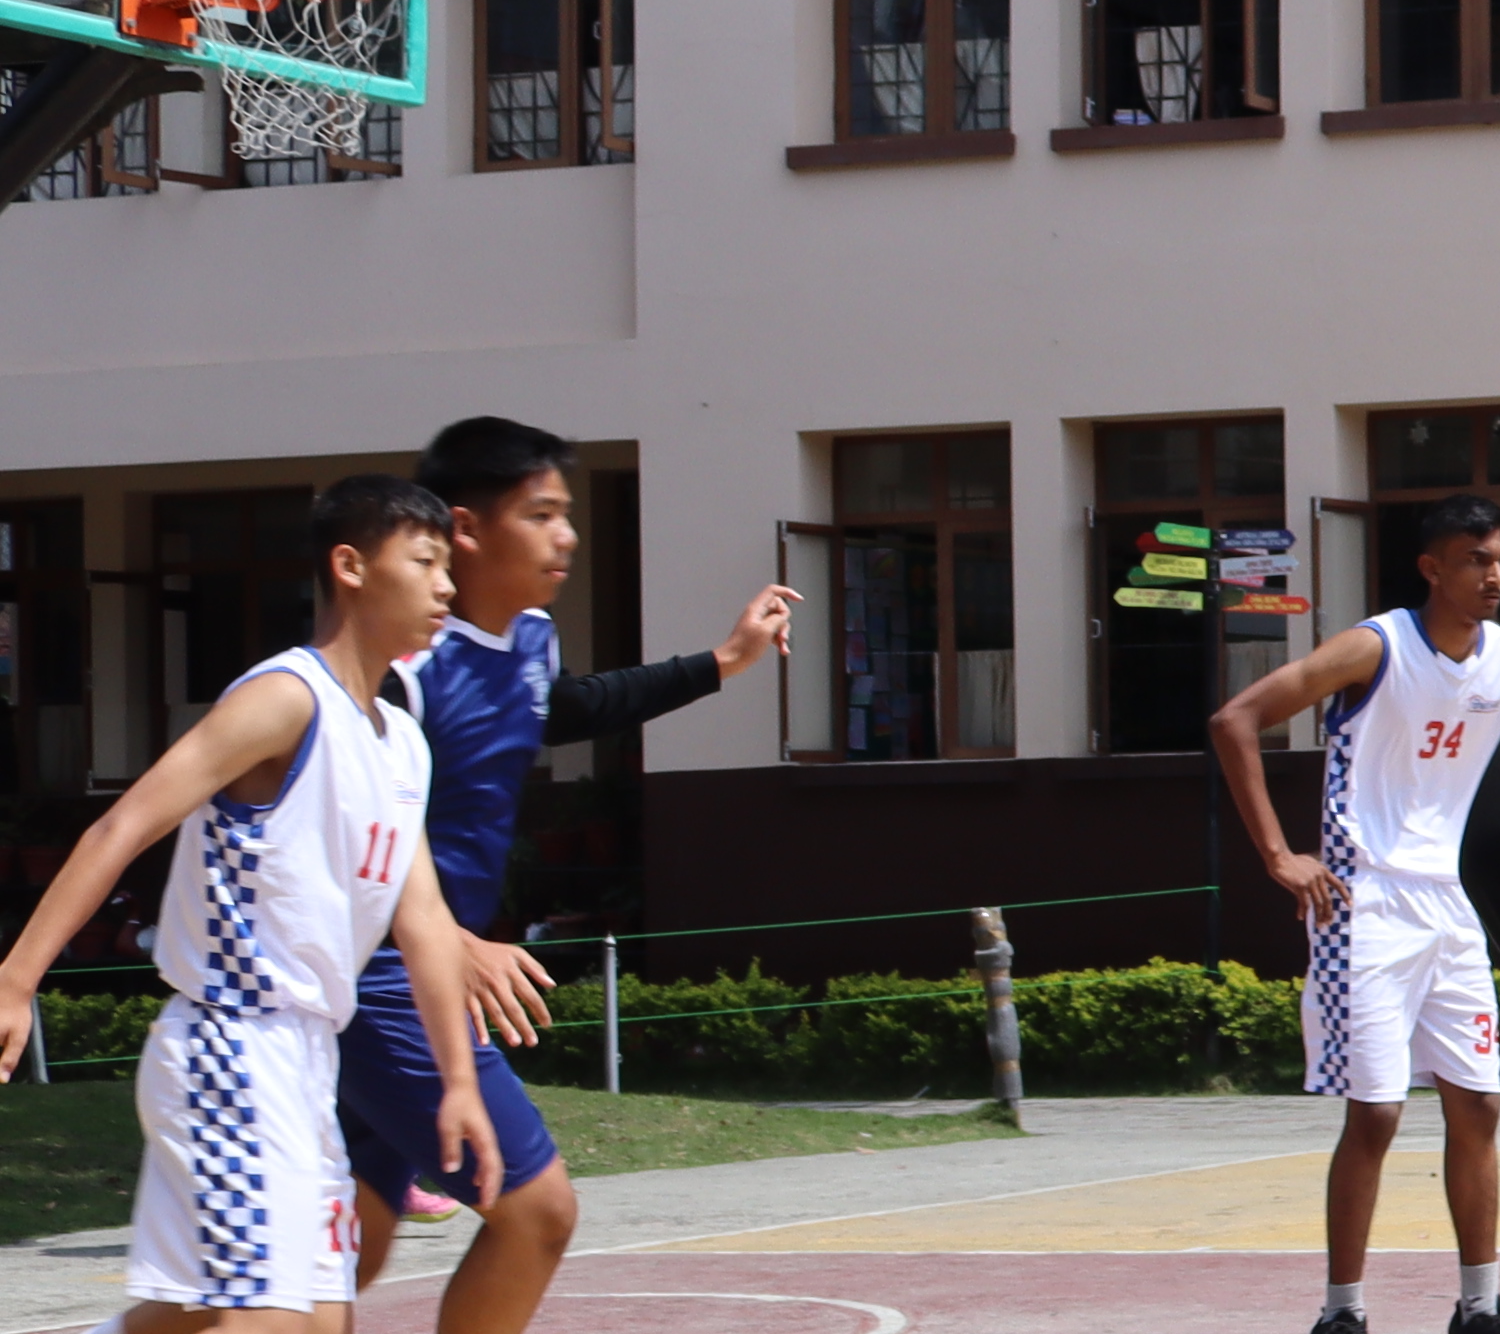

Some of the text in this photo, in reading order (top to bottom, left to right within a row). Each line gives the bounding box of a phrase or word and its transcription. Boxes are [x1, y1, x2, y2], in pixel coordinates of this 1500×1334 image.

[1418, 720, 1466, 759] 34
[355, 820, 397, 885] 11
[1474, 1013, 1500, 1055] 3
